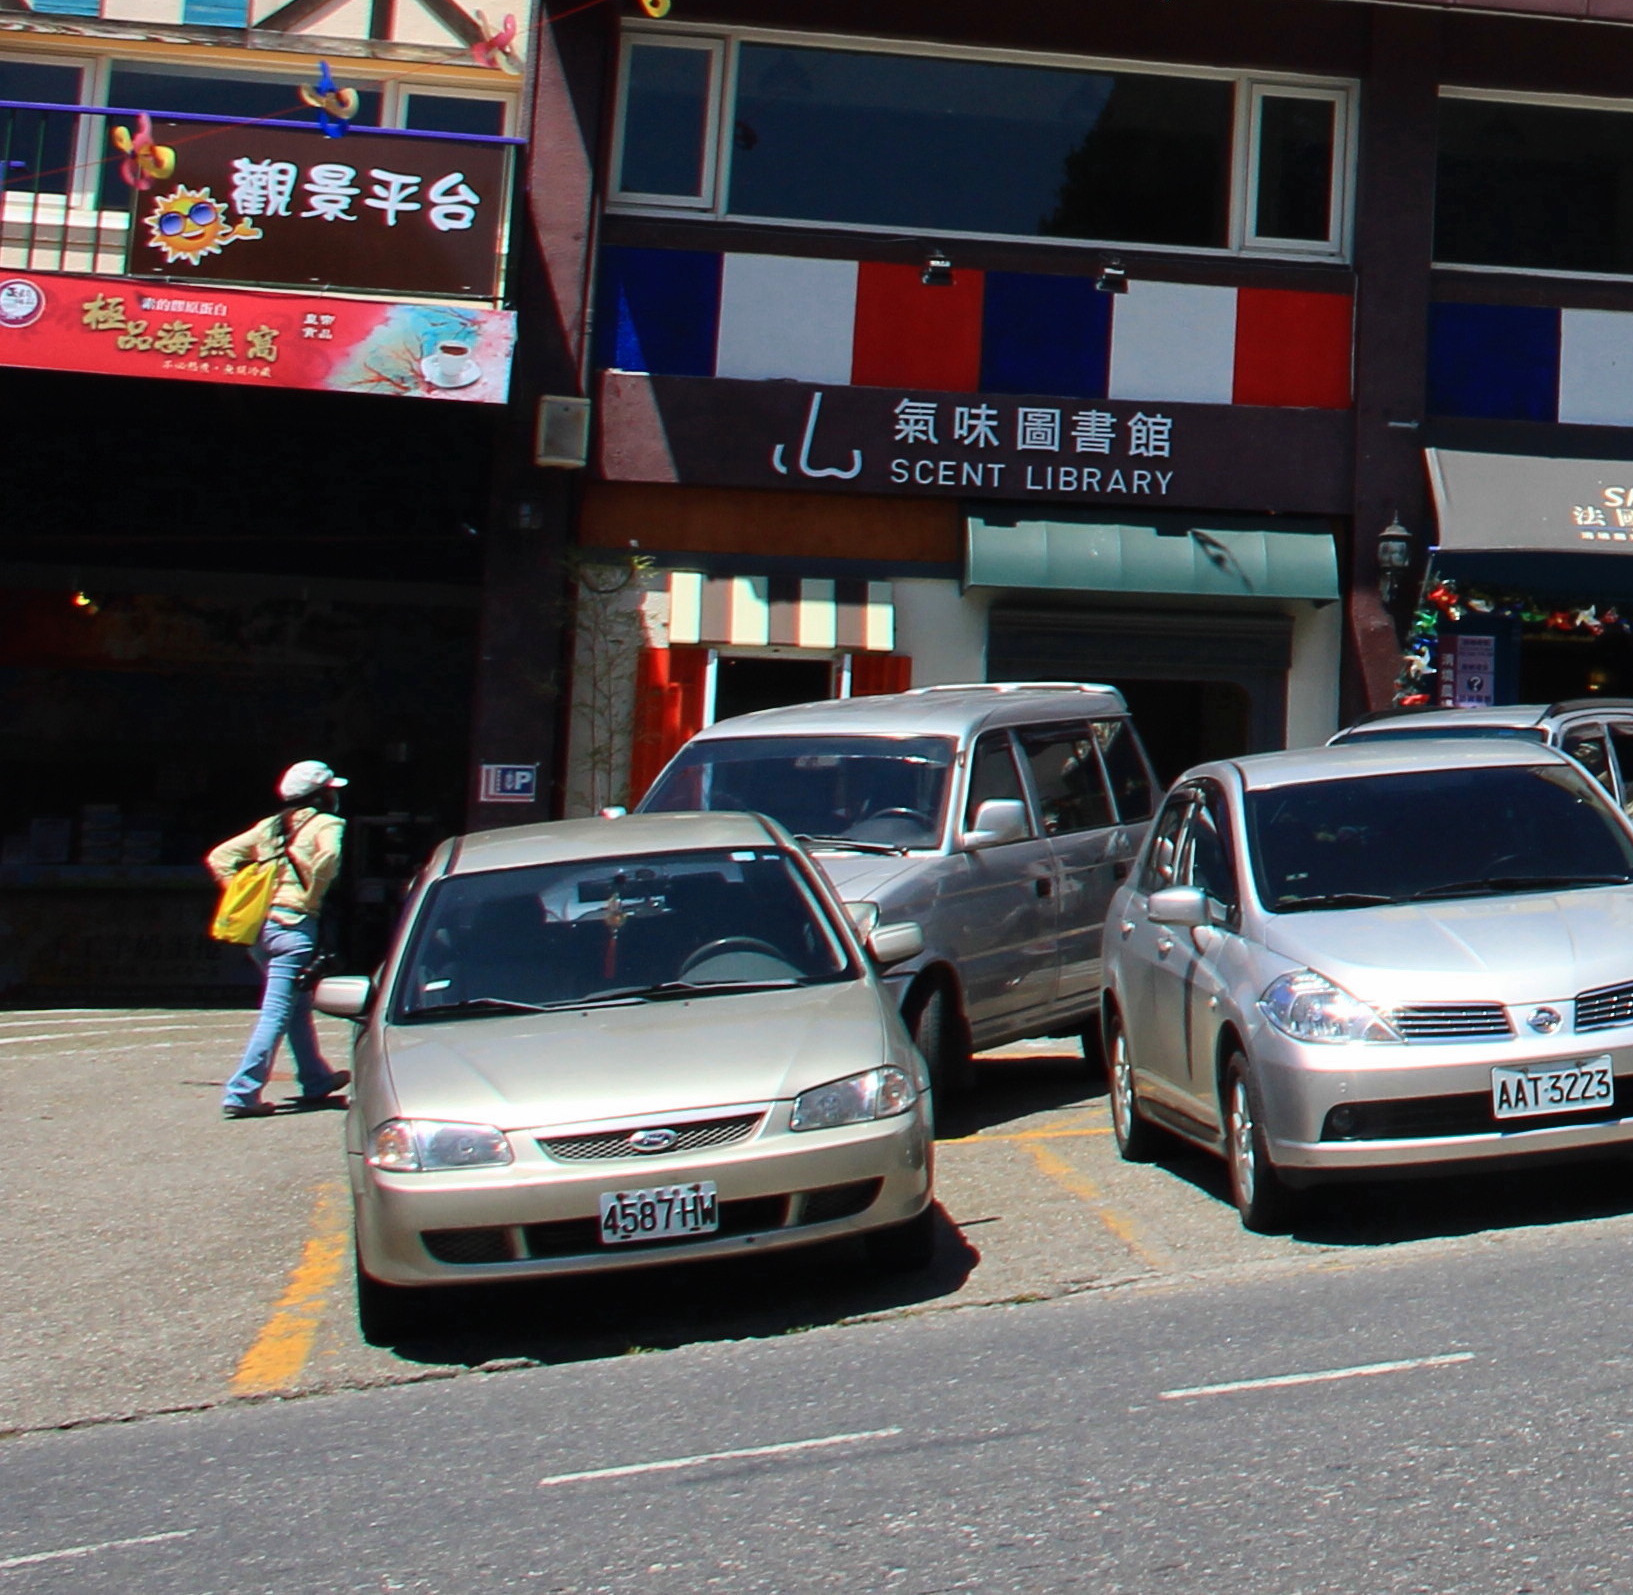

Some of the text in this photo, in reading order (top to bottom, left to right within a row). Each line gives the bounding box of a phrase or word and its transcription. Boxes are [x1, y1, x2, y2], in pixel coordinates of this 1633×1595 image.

[231, 157, 480, 232] 觀景平台
[82, 292, 281, 363] 極品海燕窩
[893, 397, 1173, 458] 氣味圖書館
[890, 458, 1174, 495] SCENT LIBRARY
[1498, 1068, 1611, 1110] AAT-3223
